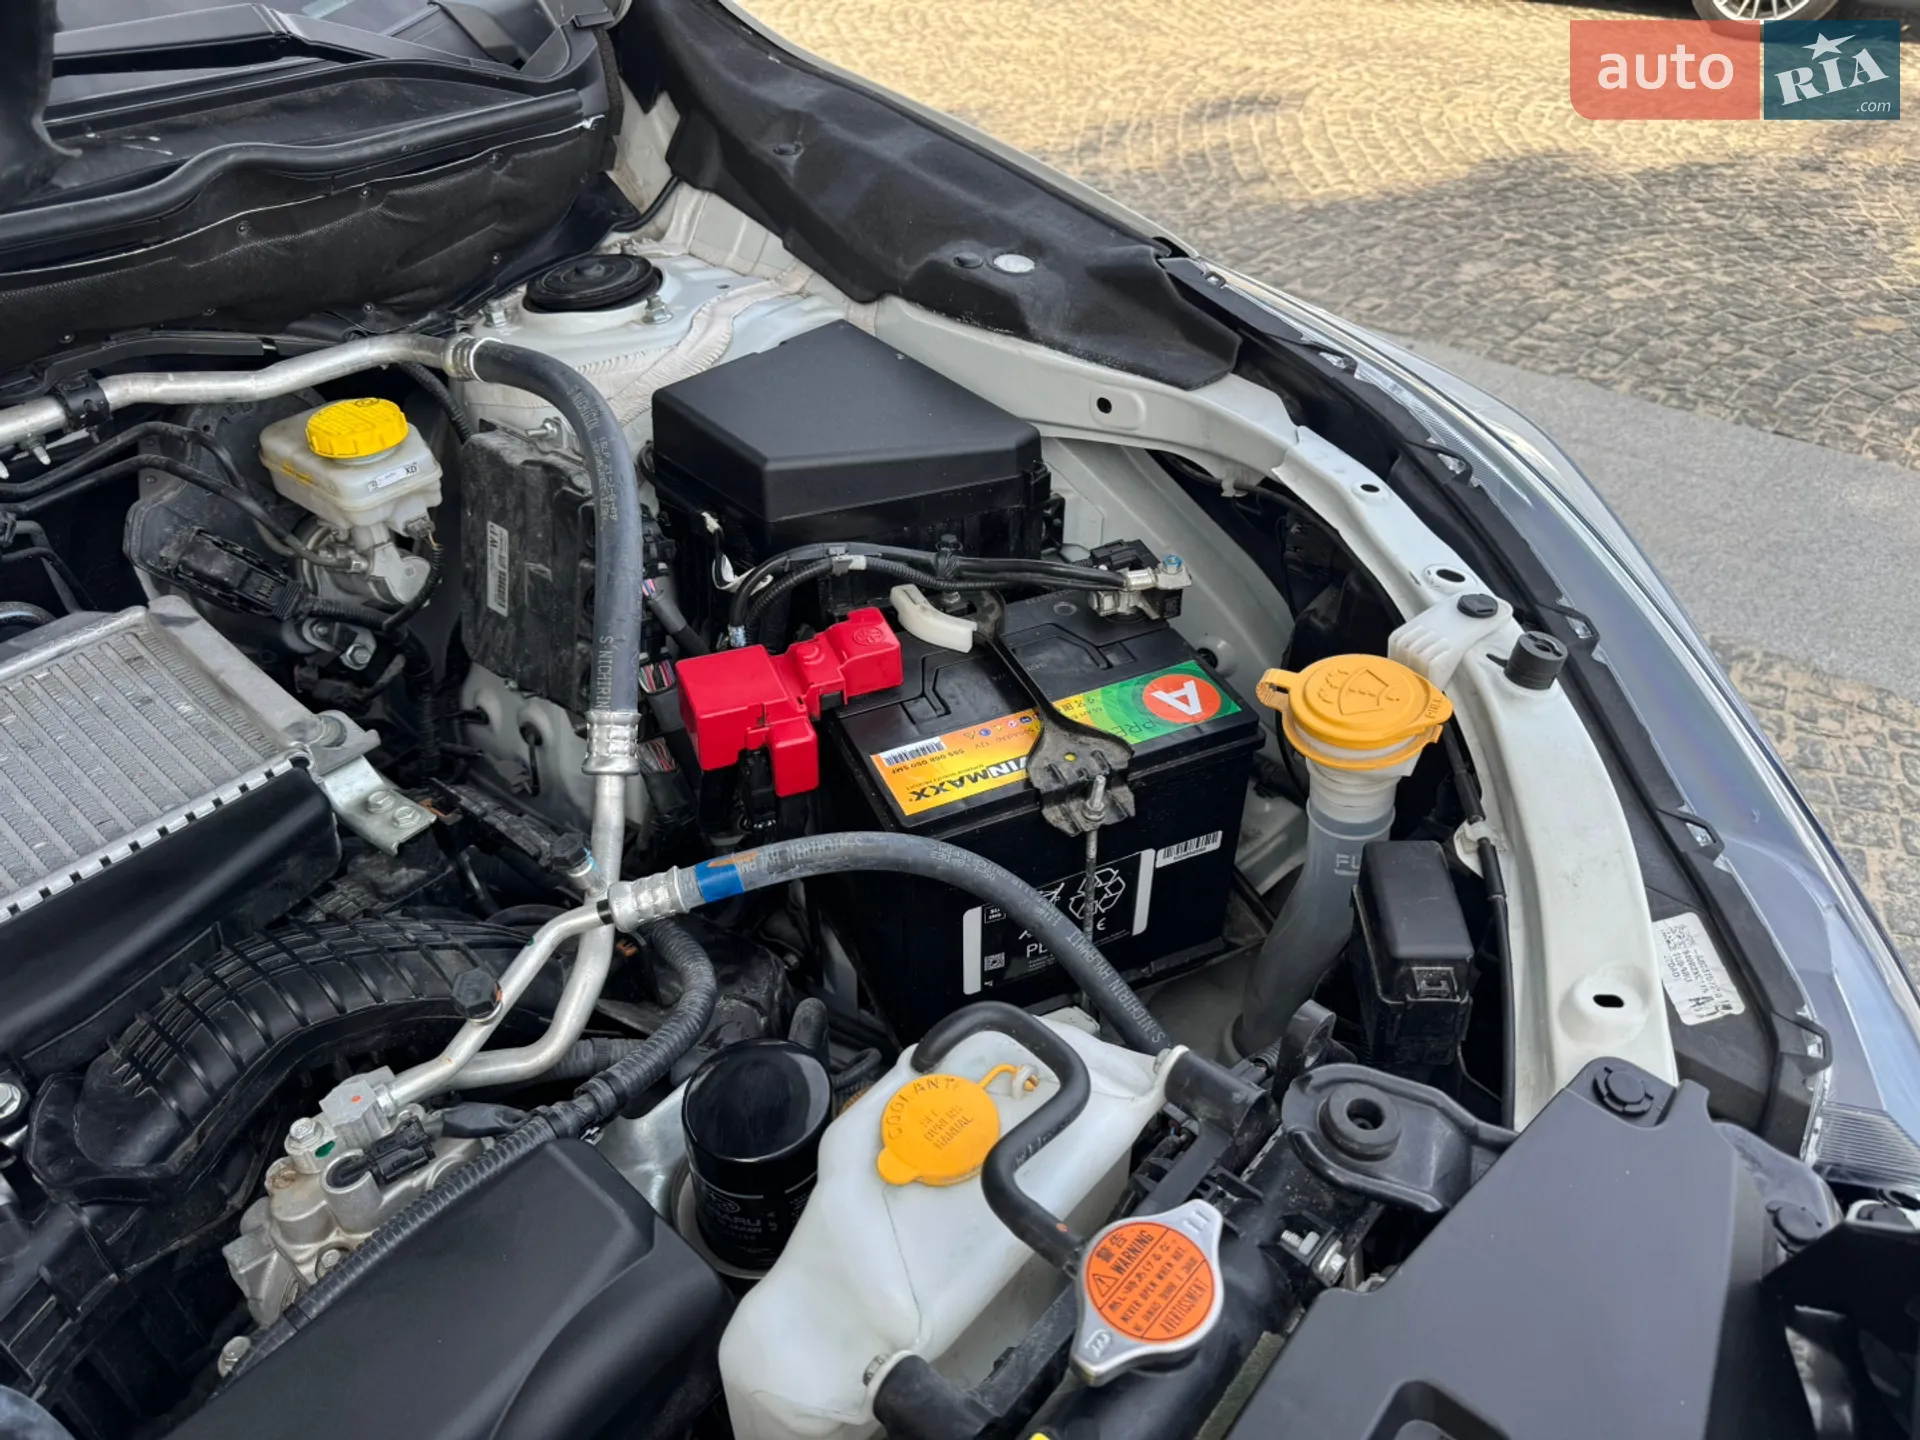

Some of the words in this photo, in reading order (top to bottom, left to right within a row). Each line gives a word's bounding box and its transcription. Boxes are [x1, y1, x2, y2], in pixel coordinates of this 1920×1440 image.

[1151, 680, 1203, 716] A
[1111, 719, 1160, 737] PRE
[1110, 1230, 1154, 1275] WARNING
[1120, 1300, 1143, 1323] NEVER
[1140, 1281, 1158, 1300] OPEN
[1156, 1262, 1174, 1281] WHEN
